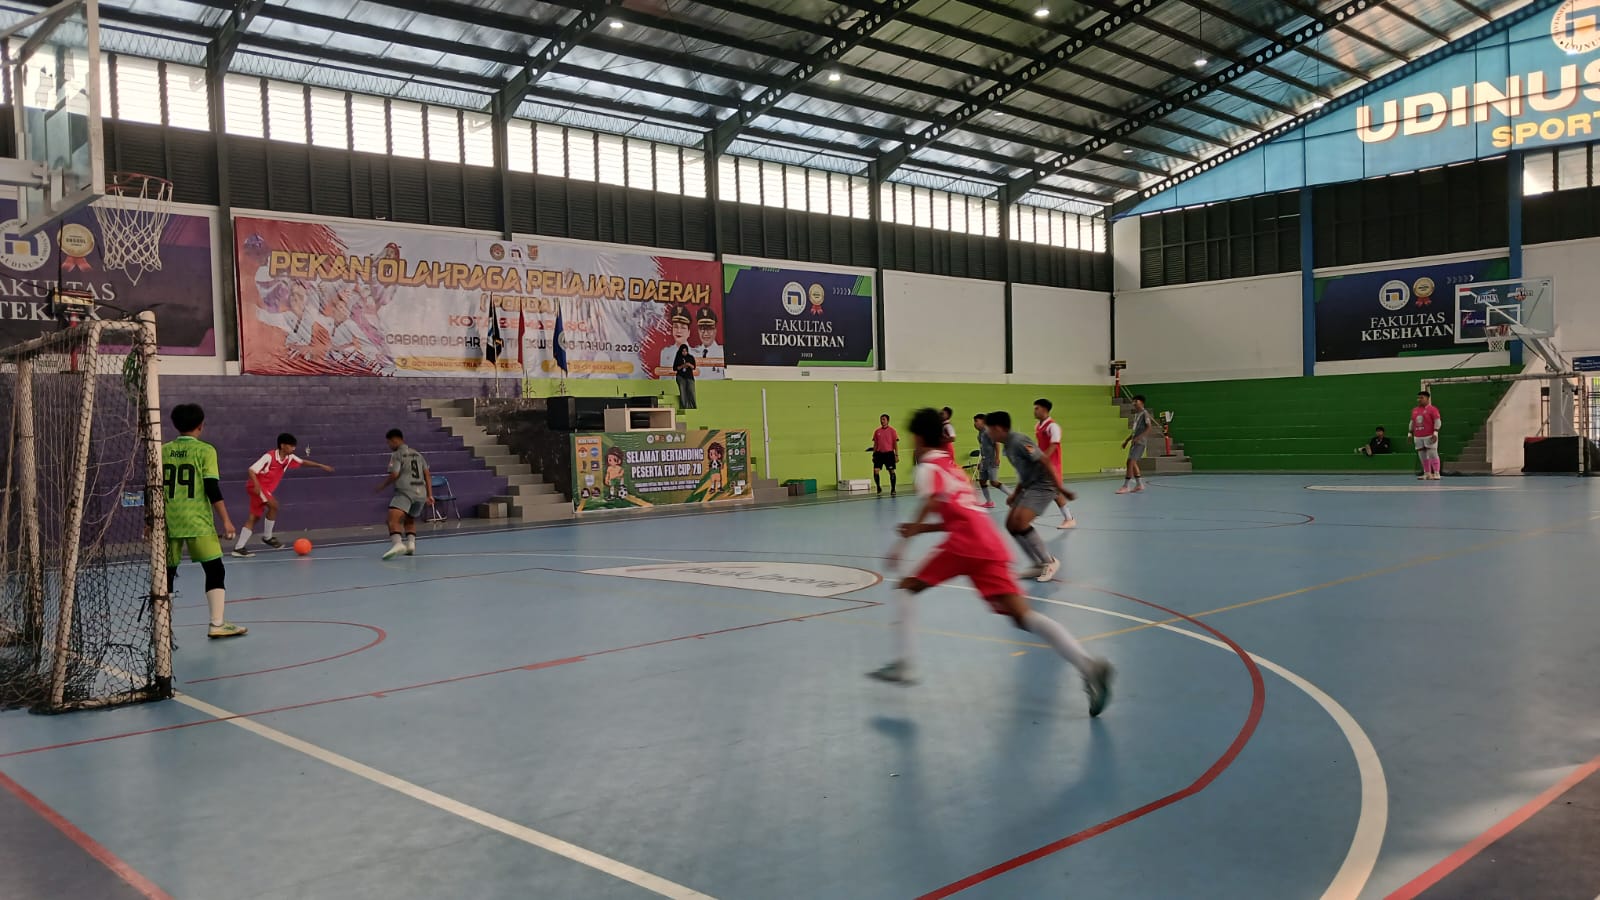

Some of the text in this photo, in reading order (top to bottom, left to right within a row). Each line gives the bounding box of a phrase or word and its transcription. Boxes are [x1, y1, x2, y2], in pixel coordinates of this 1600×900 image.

[268, 250, 712, 304] PEKAN OLAHRAGA PELAJAR DAERAH
[0, 300, 102, 321] TEKK
[775, 318, 832, 333] FAKULTAS
[1370, 312, 1445, 329] FAKULTAS
[761, 333, 845, 348] KEDOKTERAN
[1361, 323, 1454, 341] KESEHATAN
[385, 333, 437, 346] CABANG
[577, 340, 613, 351] TAHUN
[626, 448, 704, 464] SELAMAT BERTANDING
[411, 459, 420, 479] 9
[631, 463, 703, 478] PESERTA FIX CUP 7.0
[163, 463, 195, 498] 99
